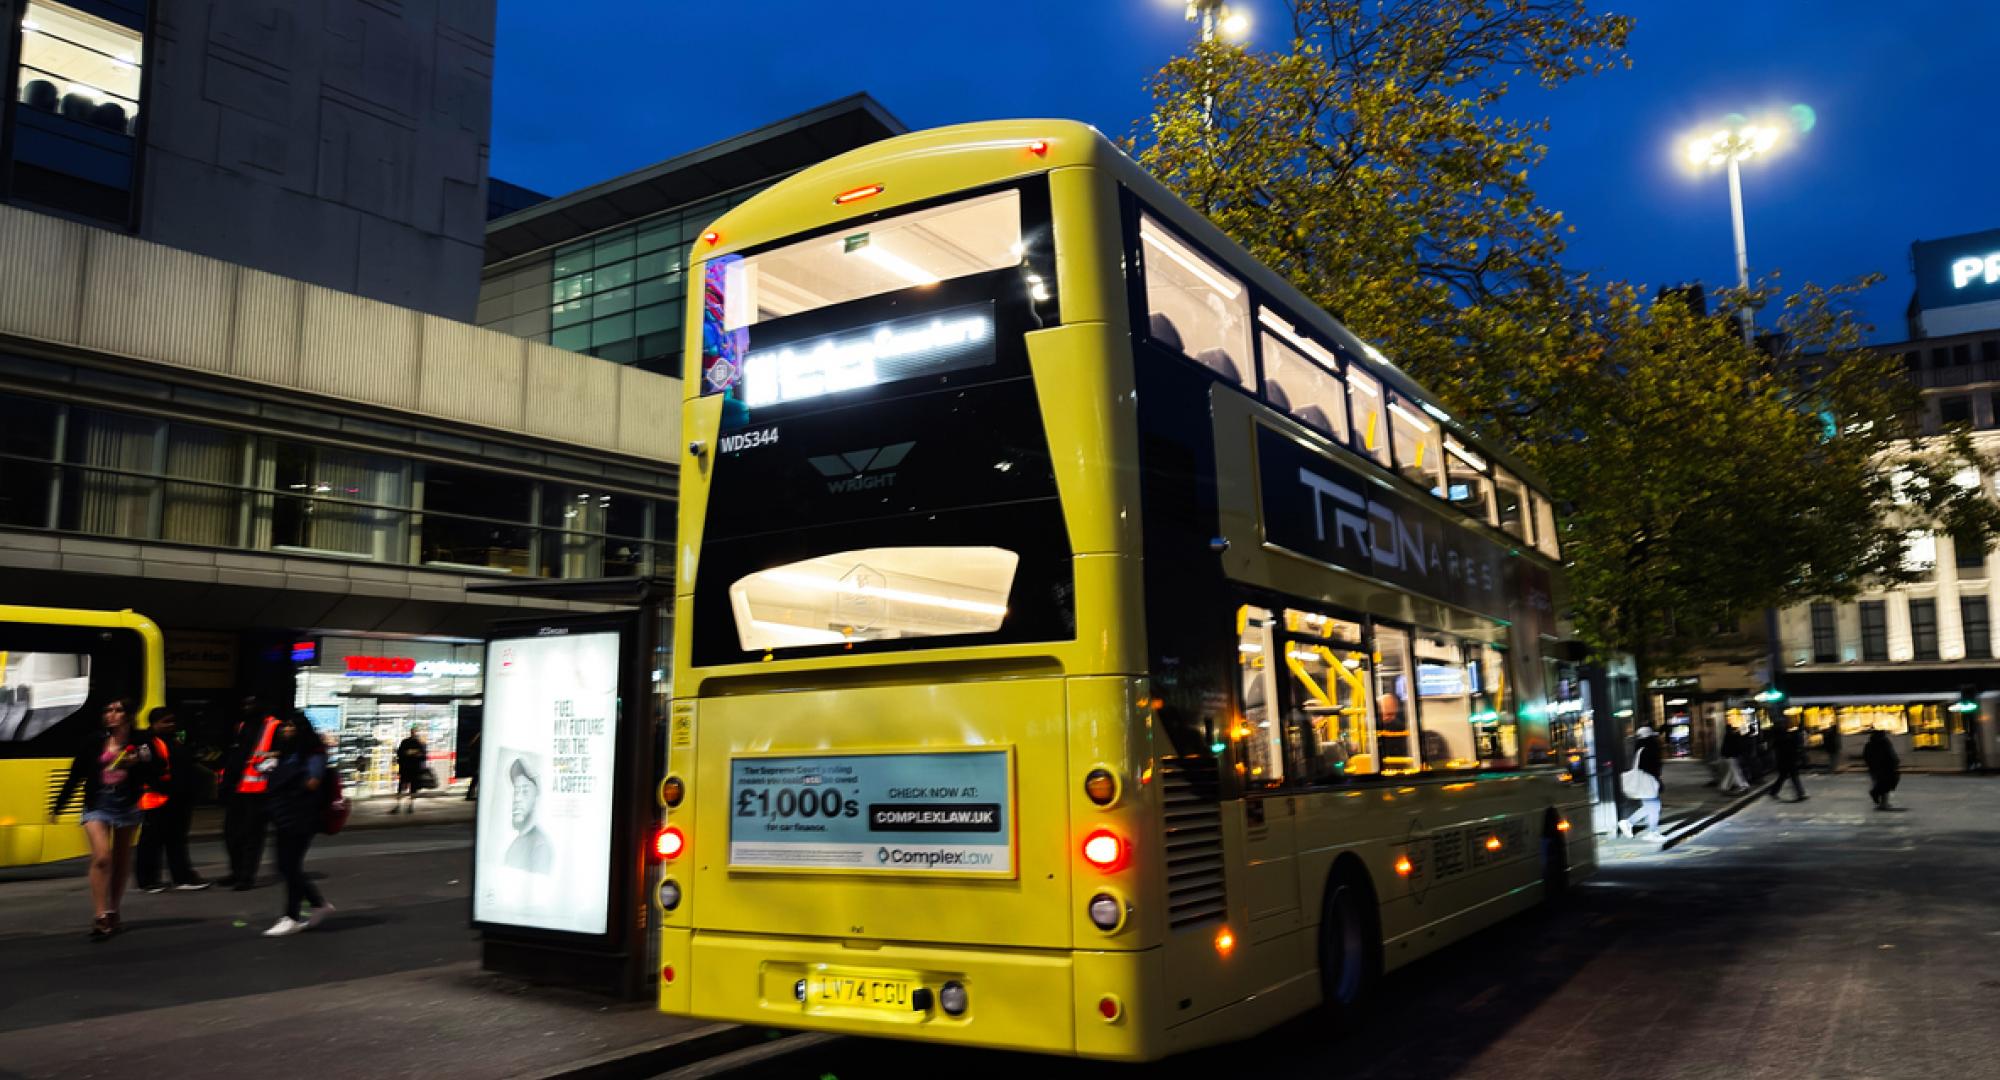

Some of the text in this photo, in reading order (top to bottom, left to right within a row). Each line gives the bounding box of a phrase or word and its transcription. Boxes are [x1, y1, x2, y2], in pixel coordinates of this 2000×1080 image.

[720, 427, 779, 453] WDS344
[827, 471, 897, 495] WRIGHT
[1299, 466, 1493, 591] TRON ARES
[569, 718, 605, 736] FUTURE
[888, 787, 928, 799] CHECK
[929, 787, 959, 798] NOW
[876, 810, 994, 824] COMPLEXLAW.UK
[891, 848, 994, 868] ComplexLaw
[822, 977, 866, 1001] LV74
